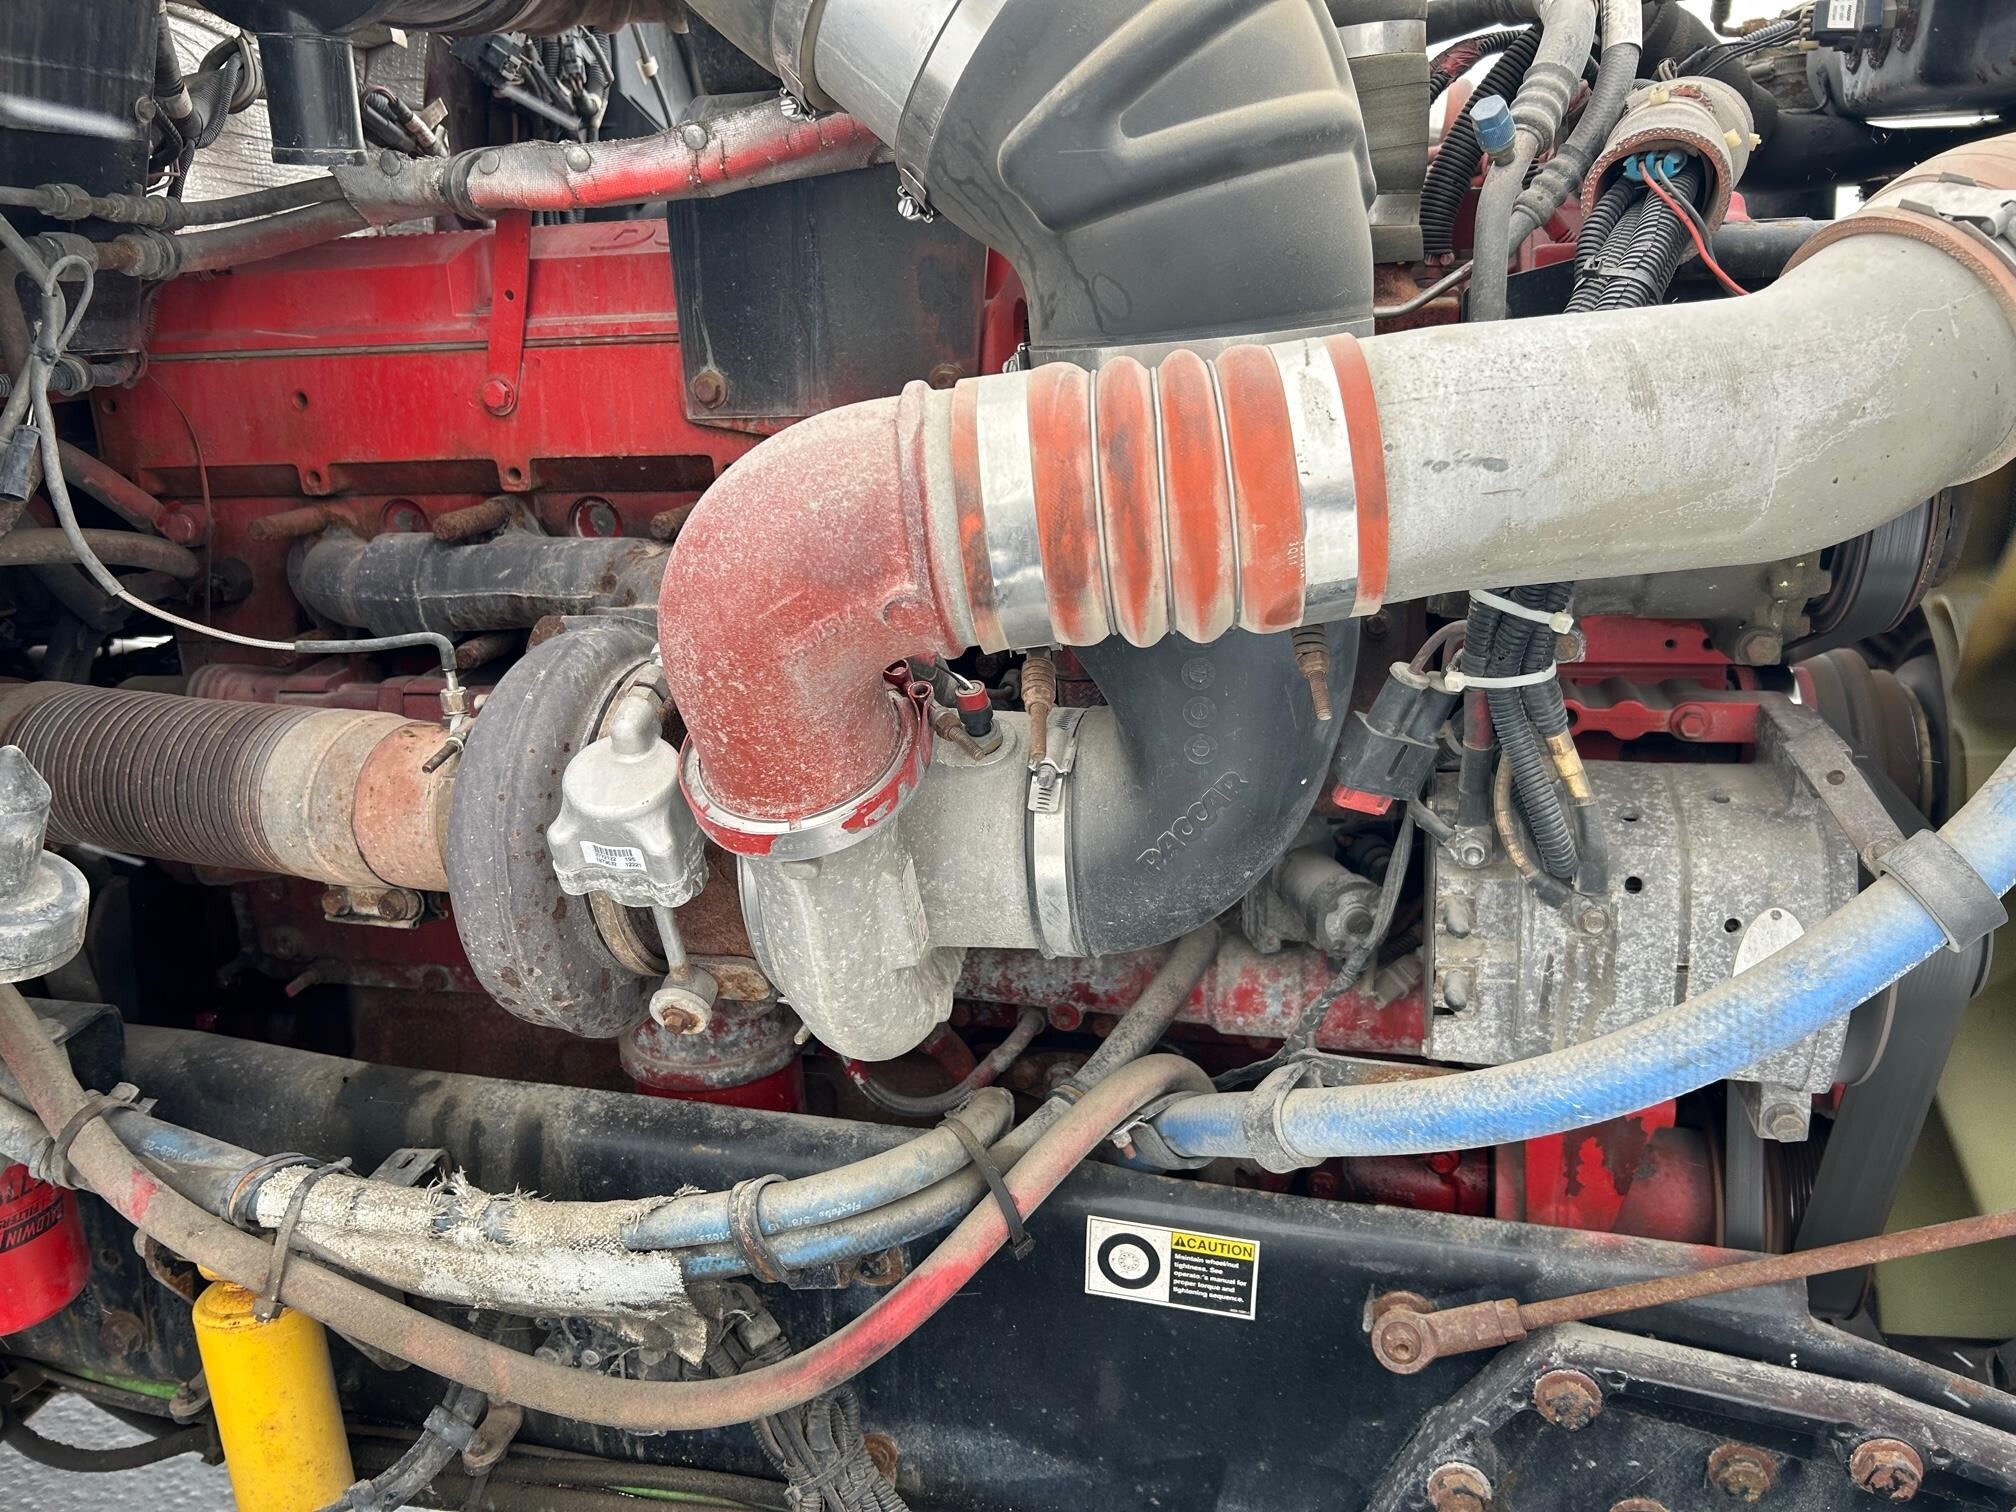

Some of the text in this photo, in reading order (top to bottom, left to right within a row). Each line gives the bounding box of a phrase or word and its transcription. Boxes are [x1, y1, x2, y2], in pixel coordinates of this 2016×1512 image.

[1136, 771, 1249, 872] PACCAR
[1187, 1238, 1253, 1258] CAUTION
[1174, 1253, 1204, 1263] Maintain
[1174, 1262, 1223, 1275] tightness. See
[1173, 1279, 1236, 1293] proper torque and
[1210, 1276, 1236, 1285] manual
[1237, 1279, 1248, 1287] for
[1173, 1287, 1208, 1298] tightening
